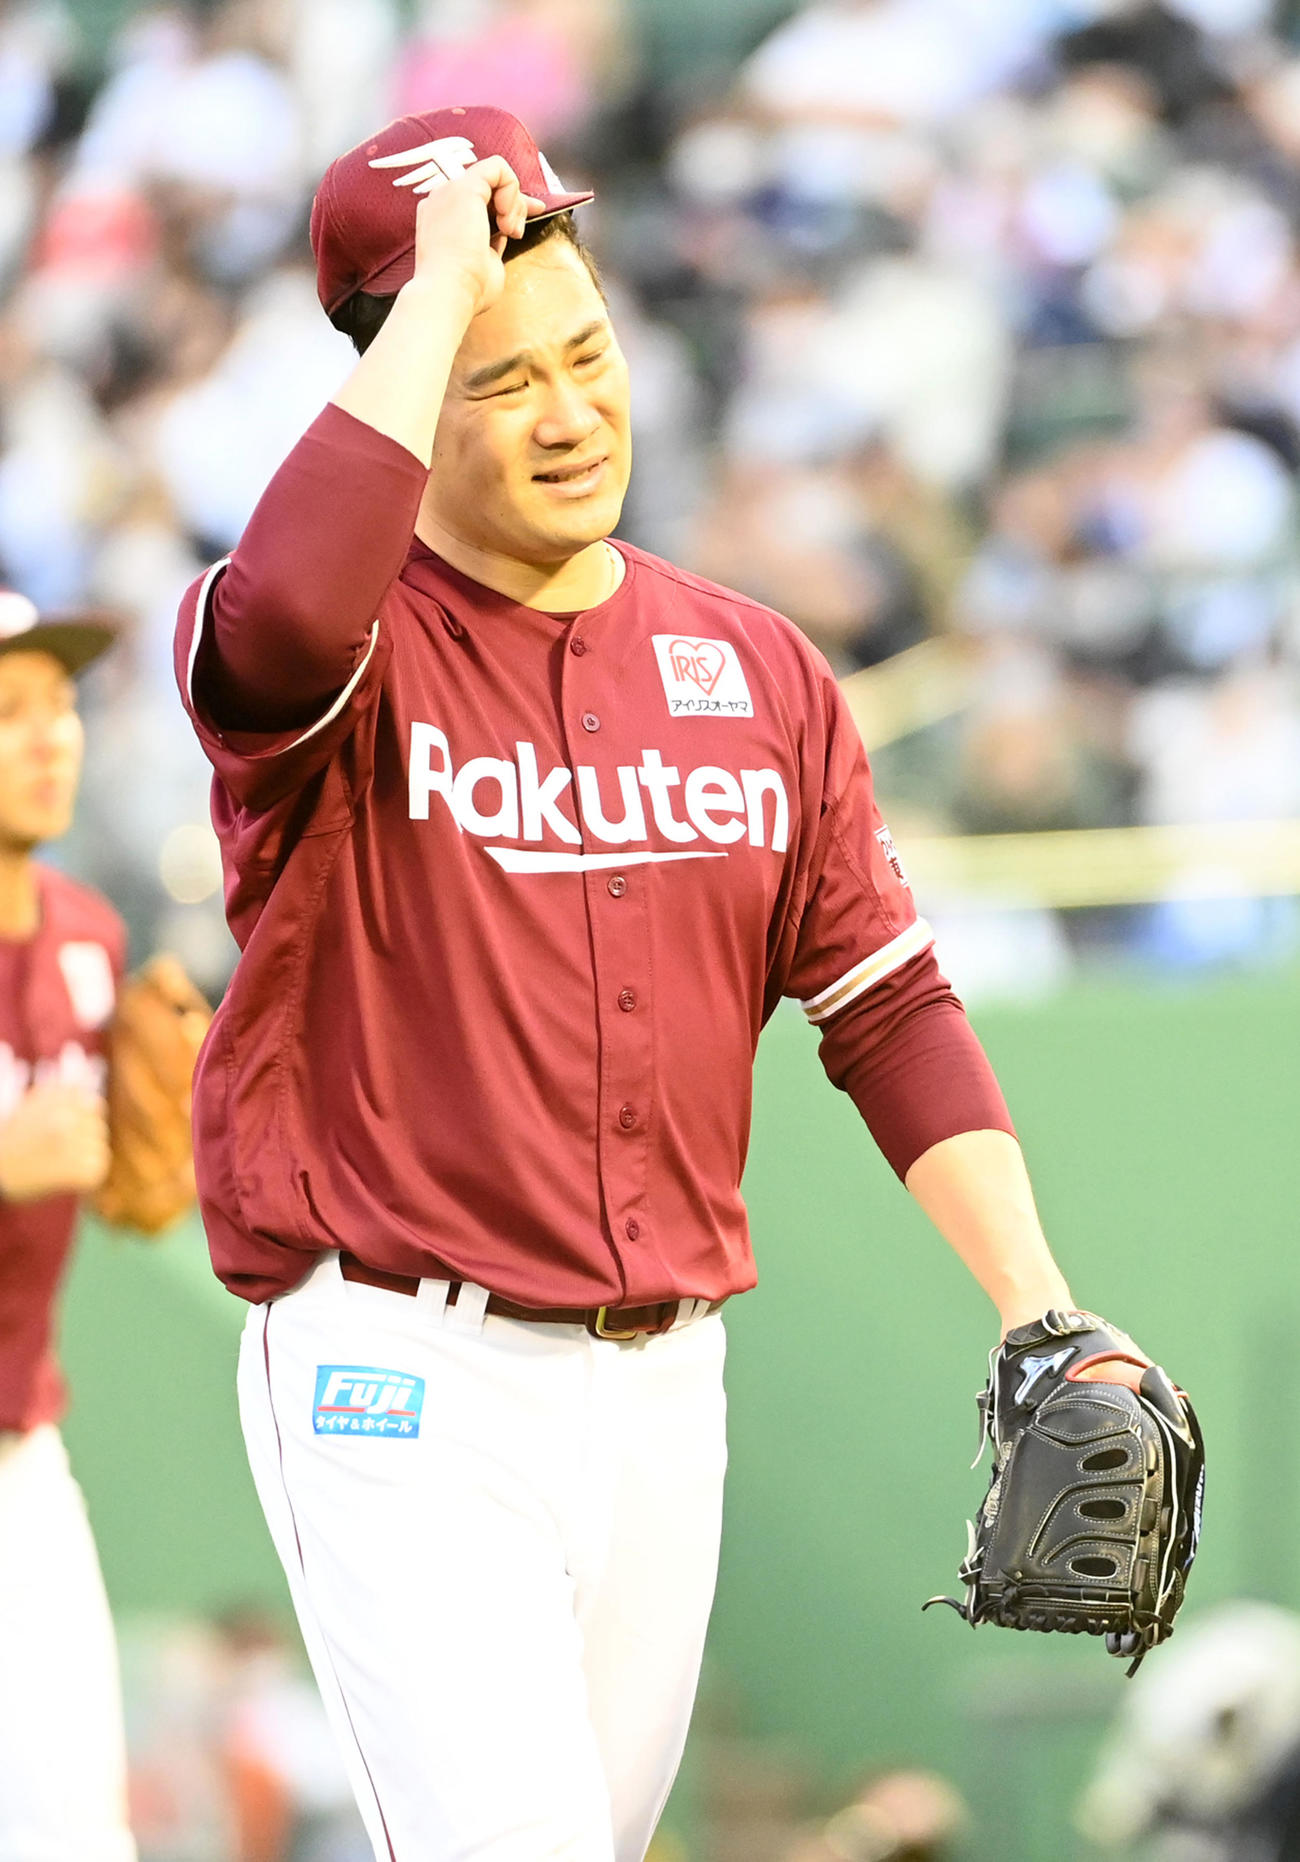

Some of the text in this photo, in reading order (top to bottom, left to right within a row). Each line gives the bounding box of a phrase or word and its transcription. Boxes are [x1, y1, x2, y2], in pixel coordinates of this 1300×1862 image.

[670, 655, 712, 682] IRIS
[671, 699, 748, 712] アイリスオーヤマ
[408, 721, 789, 853] Rakuten
[321, 1371, 417, 1414] Fuji
